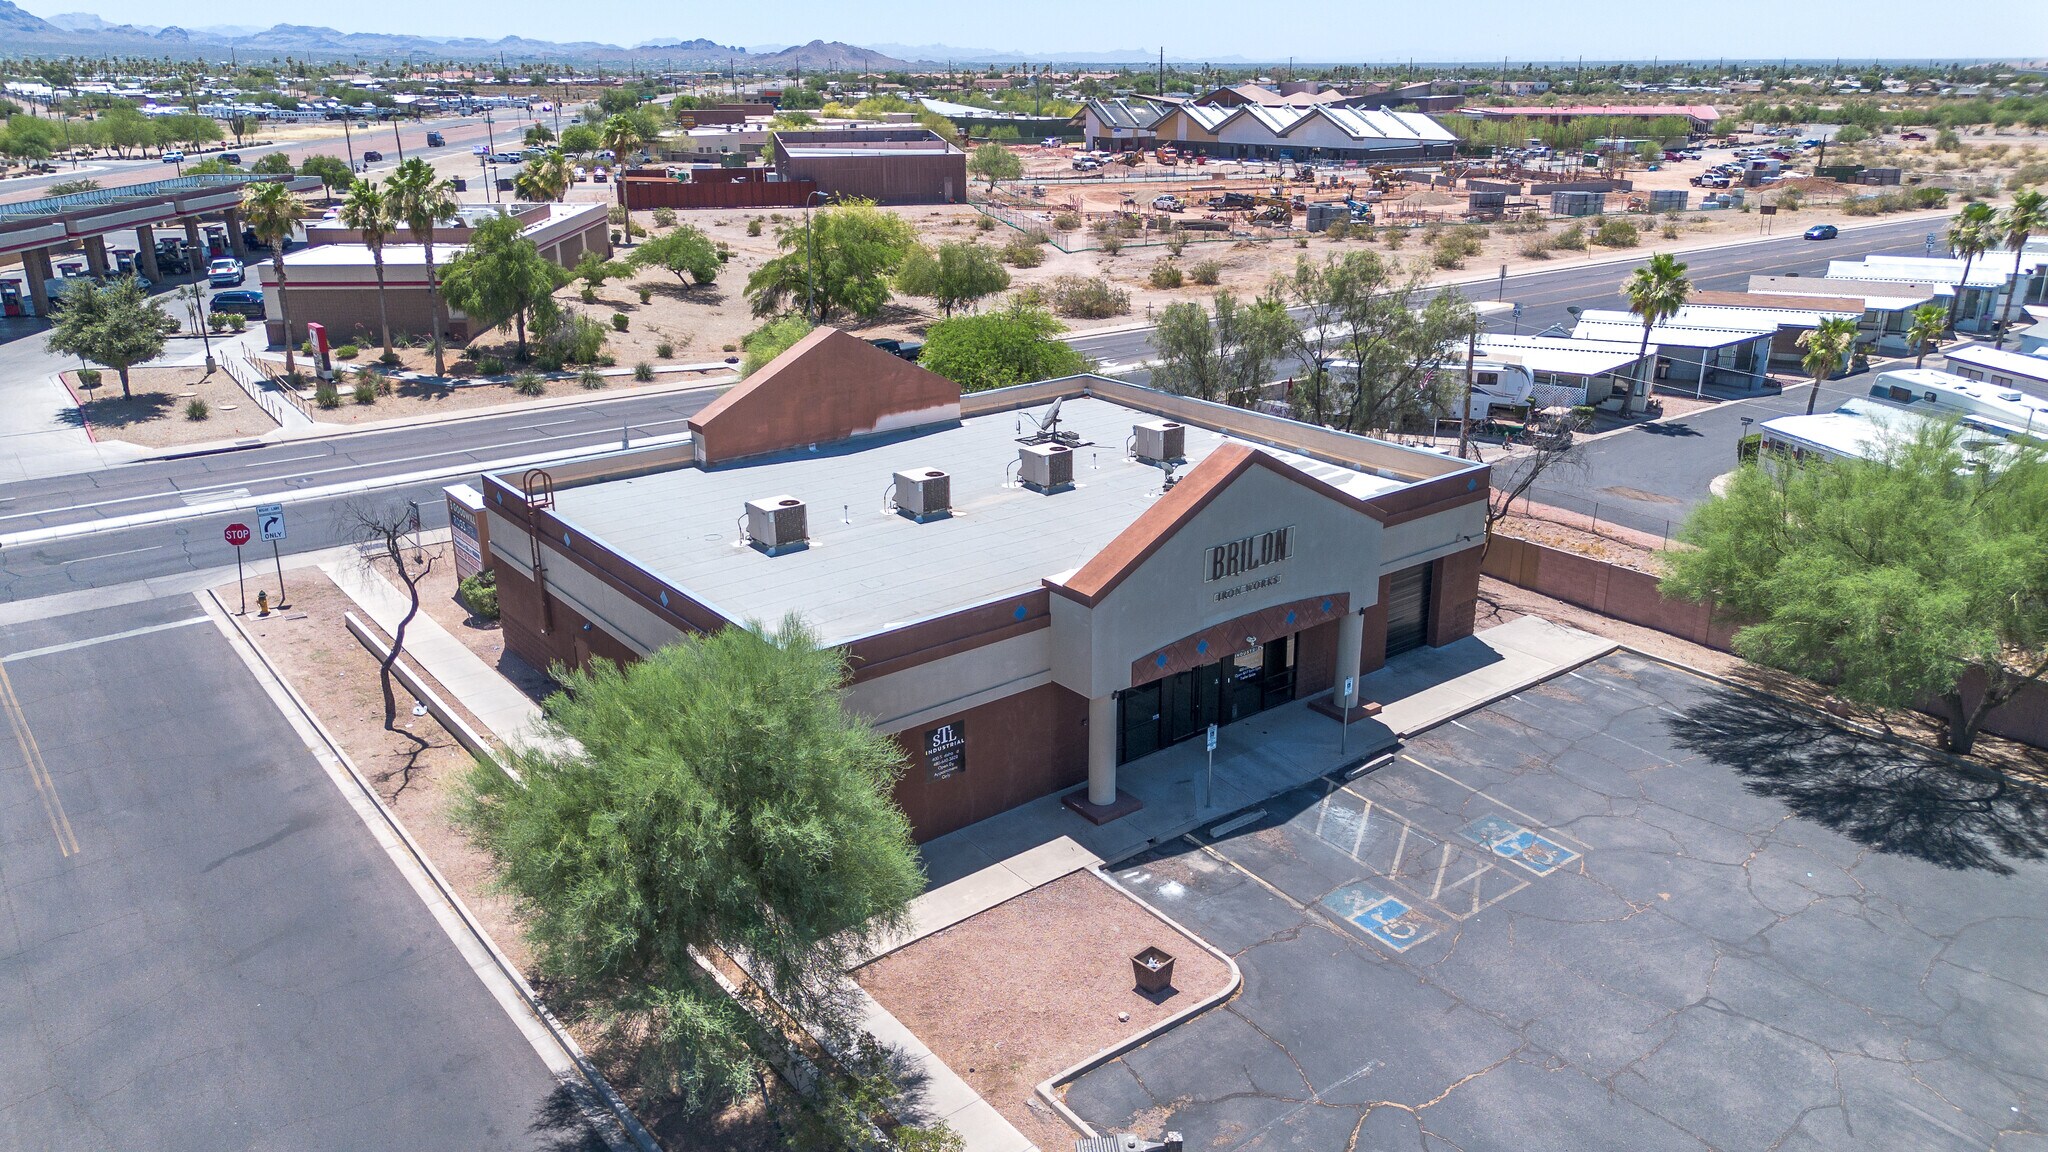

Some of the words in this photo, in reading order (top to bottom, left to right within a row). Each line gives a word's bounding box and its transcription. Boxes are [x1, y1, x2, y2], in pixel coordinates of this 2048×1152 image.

[226, 530, 249, 540] STOP
[264, 531, 282, 539] ONLY
[1212, 528, 1288, 581] BRILON
[1217, 588, 1242, 601] IRON
[1245, 576, 1279, 592] WORKS
[933, 725, 957, 747] STL
[925, 738, 965, 756] INDUSTRIAL
